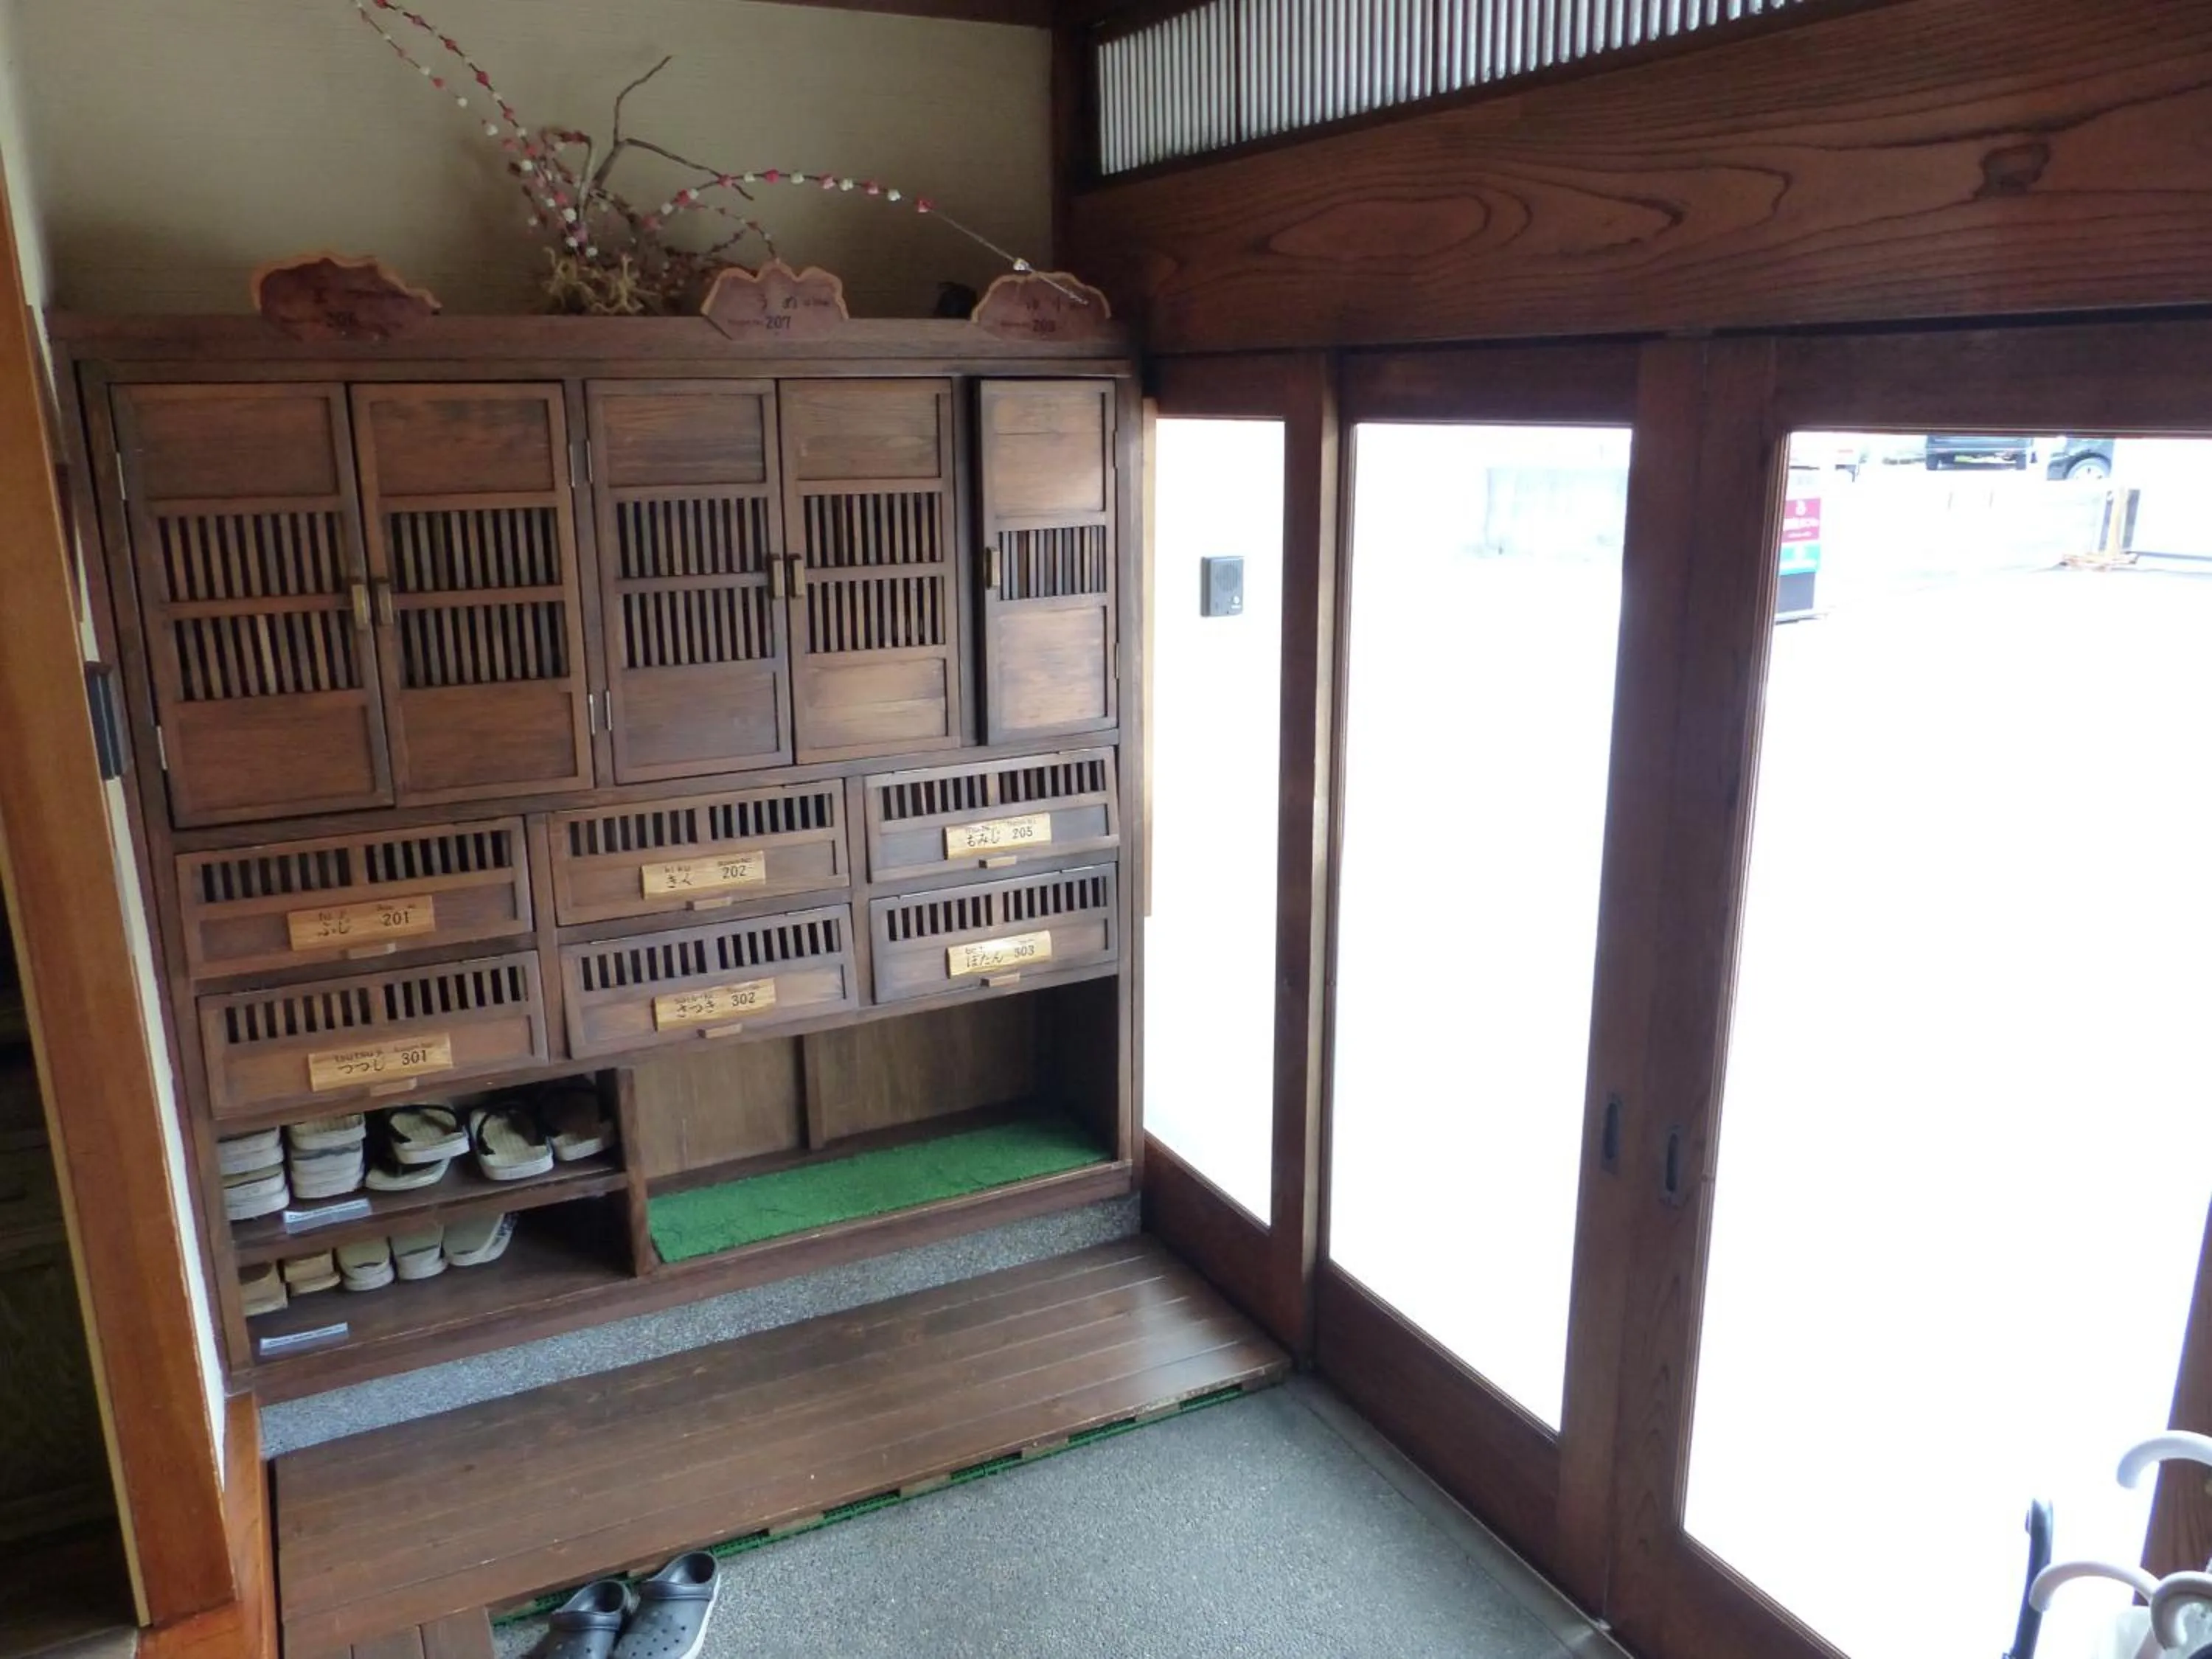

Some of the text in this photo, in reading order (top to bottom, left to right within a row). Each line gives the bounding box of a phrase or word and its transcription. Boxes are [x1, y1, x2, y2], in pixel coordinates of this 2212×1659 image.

[765, 315, 792, 330] 207
[1012, 825, 1034, 840] 205
[666, 864, 748, 888] きく 202
[382, 910, 411, 927] 201
[1014, 945, 1035, 959] 303
[676, 999, 716, 1018] さつき
[731, 991, 757, 1007] 302
[337, 1048, 427, 1074] つつじ 301
